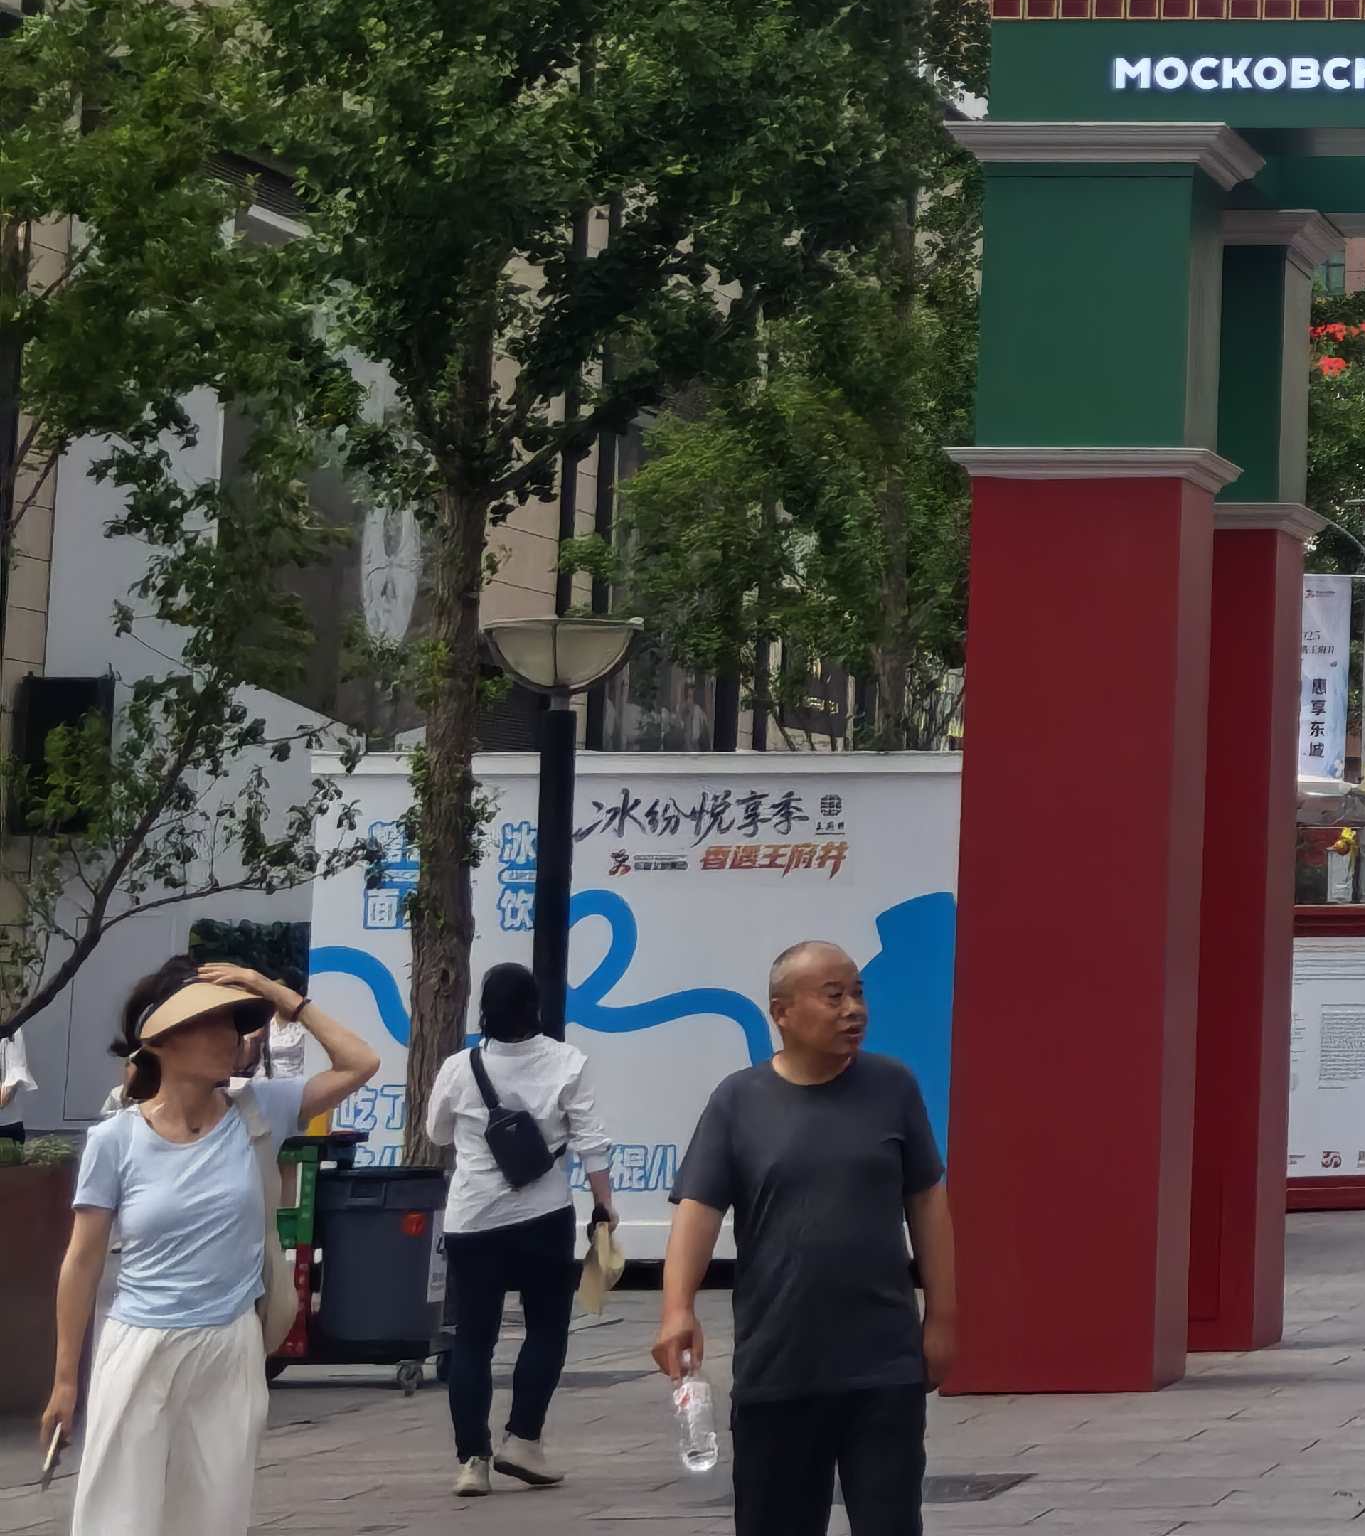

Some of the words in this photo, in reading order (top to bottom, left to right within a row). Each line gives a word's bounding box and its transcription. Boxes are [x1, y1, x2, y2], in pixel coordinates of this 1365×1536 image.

[570, 787, 810, 848] 冰纷悦享季
